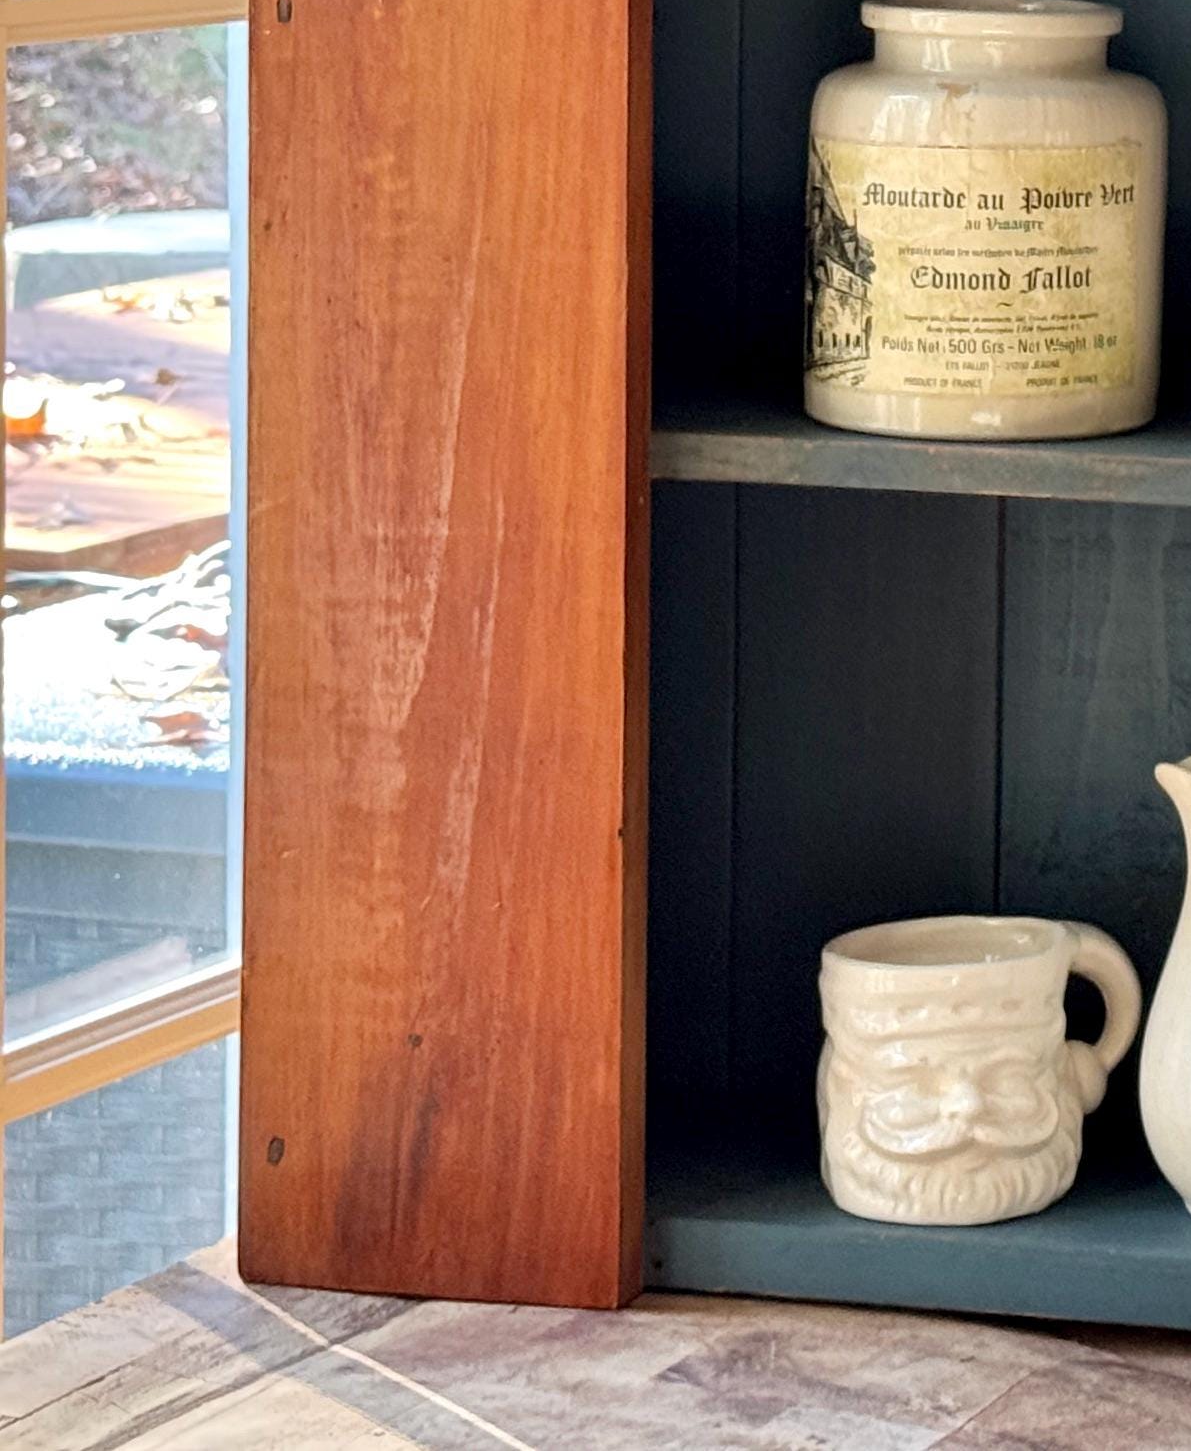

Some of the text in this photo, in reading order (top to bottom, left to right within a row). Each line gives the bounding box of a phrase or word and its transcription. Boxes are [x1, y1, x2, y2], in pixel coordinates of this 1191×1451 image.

[862, 182, 1135, 214] Moutarde au Poivre Vert
[965, 219, 981, 231] au
[910, 265, 1092, 294] Edmond Fallot
[882, 336, 914, 352] Poids
[948, 339, 976, 354] 500
[982, 340, 1005, 354] Grs
